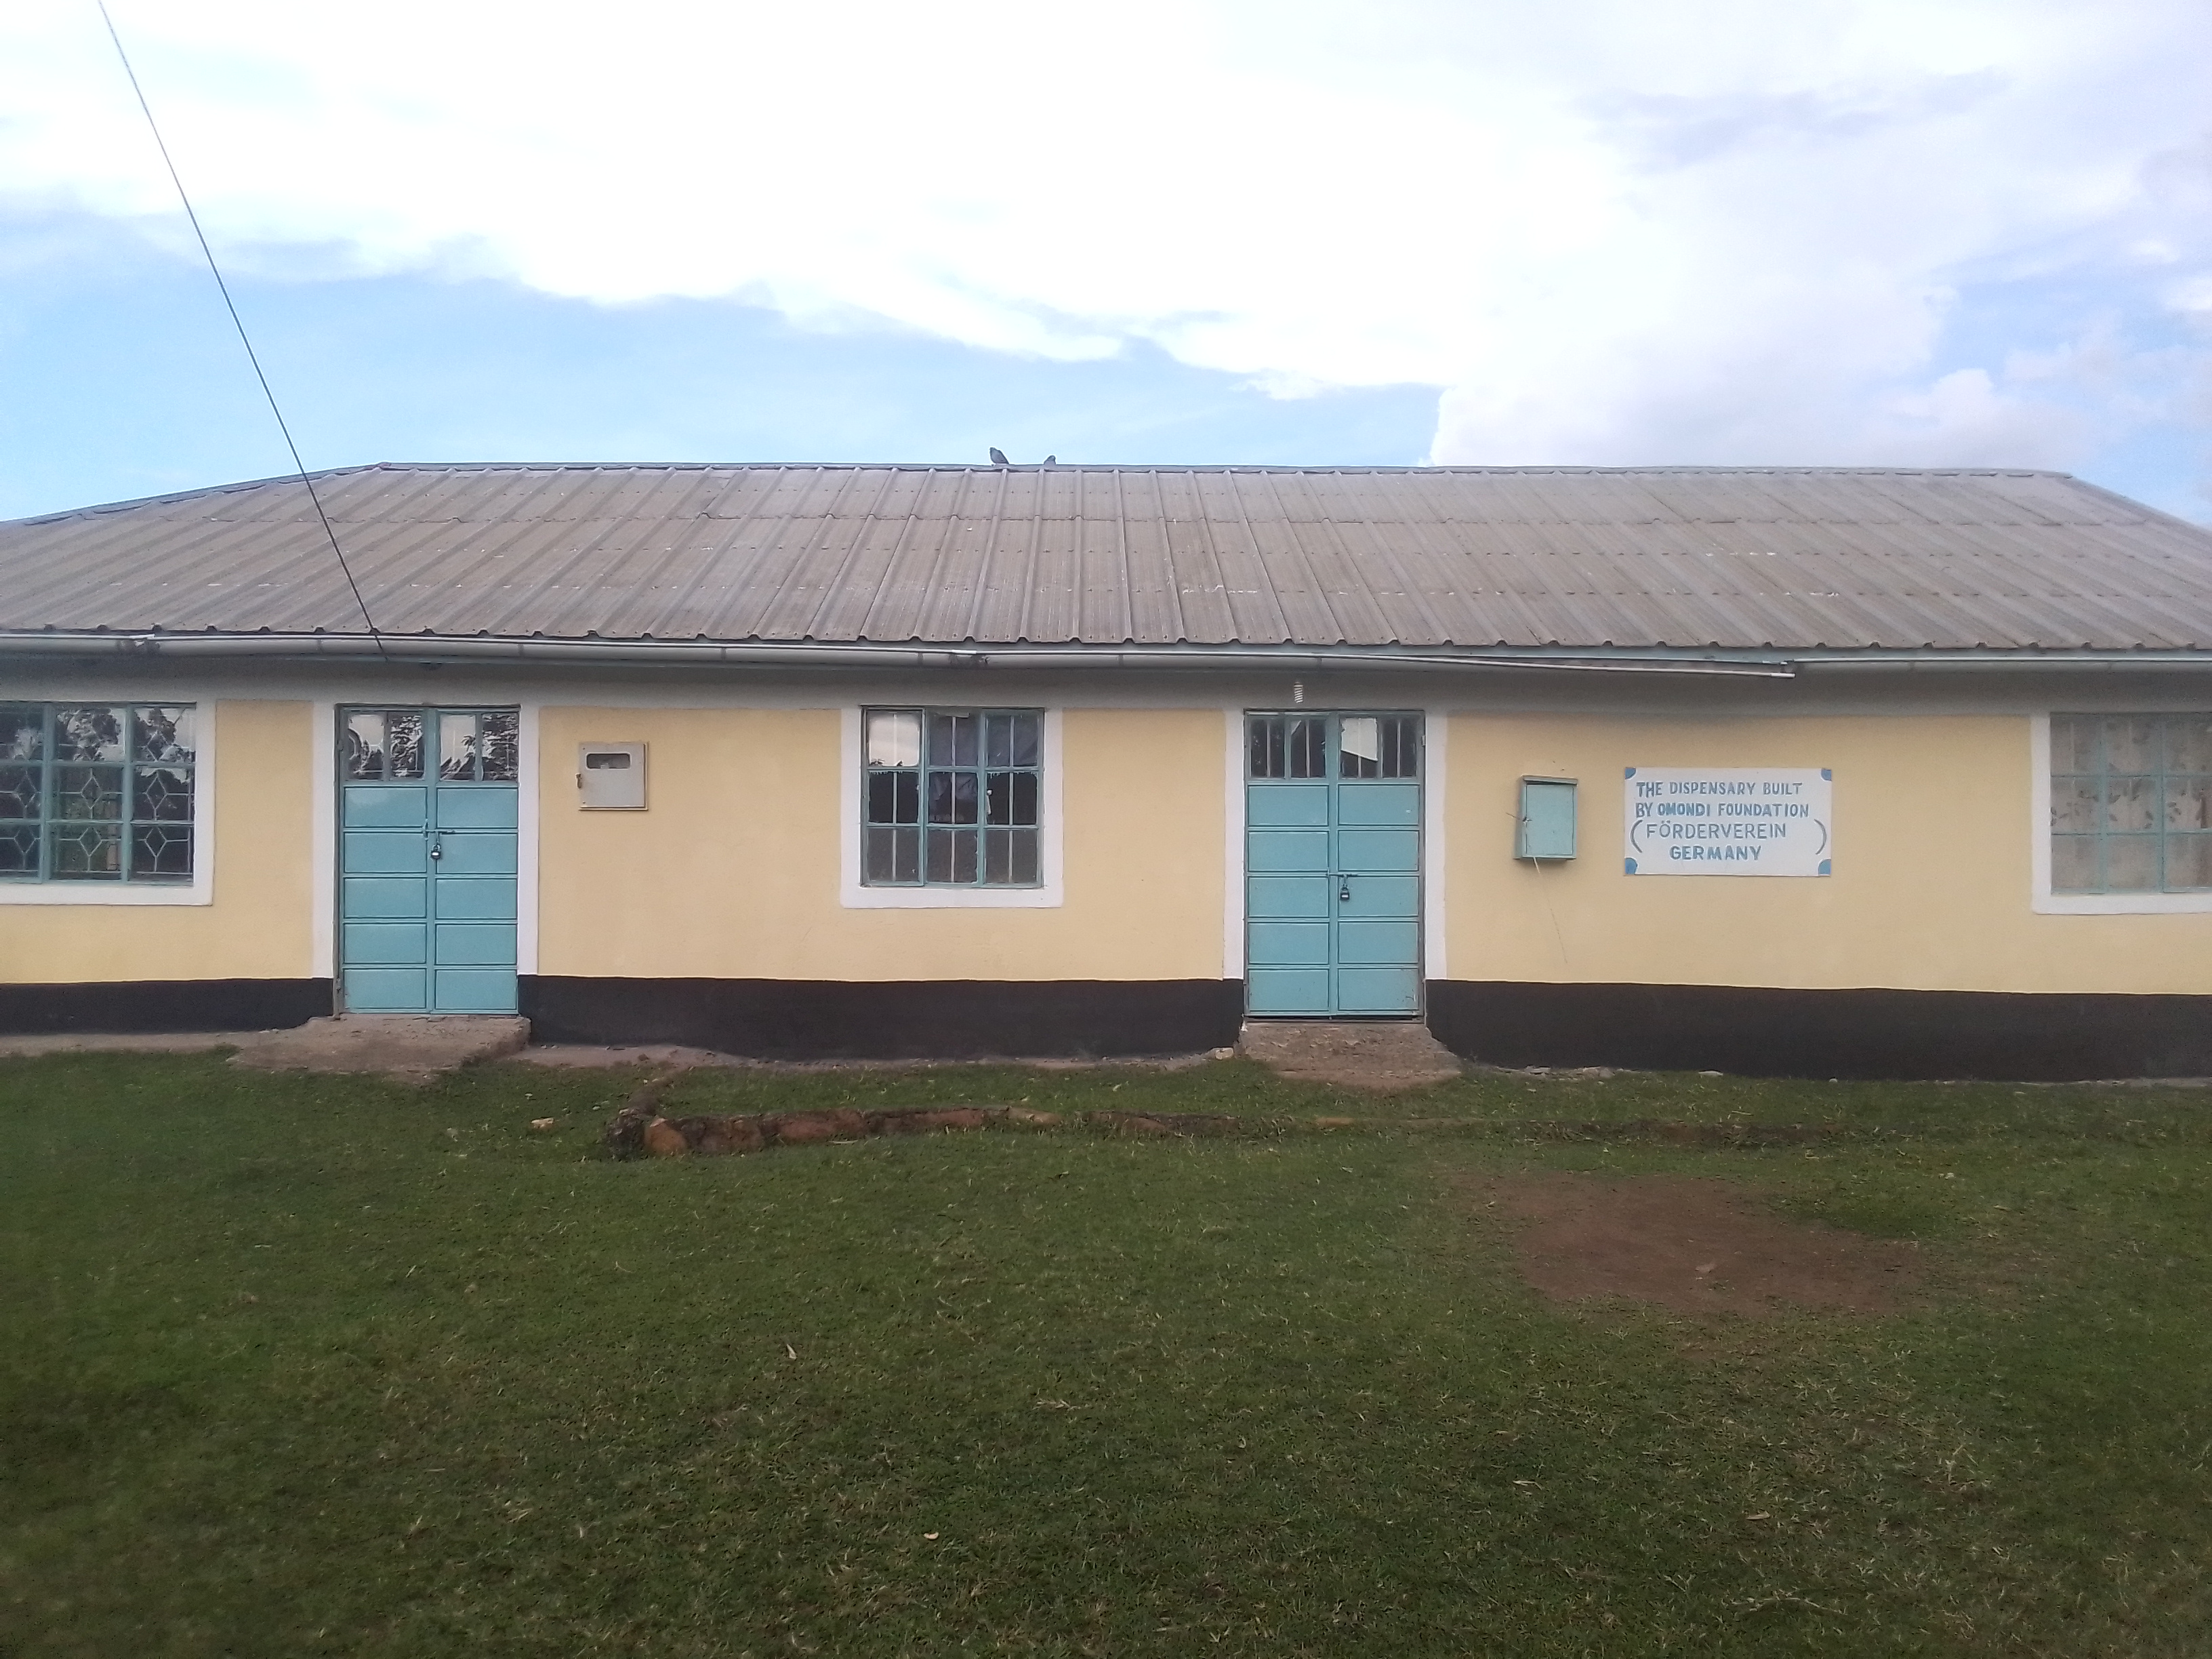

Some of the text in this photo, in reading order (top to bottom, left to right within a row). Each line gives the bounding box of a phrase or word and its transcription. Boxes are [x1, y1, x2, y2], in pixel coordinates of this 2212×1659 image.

[1636, 781, 1803, 798] THE DISPENSARY BUILT
[1635, 802, 1809, 818] BY OMONDI FOUNDATION
[1646, 820, 1786, 839] FÖRDERVEREIN
[1669, 845, 1761, 861] GERMANY
